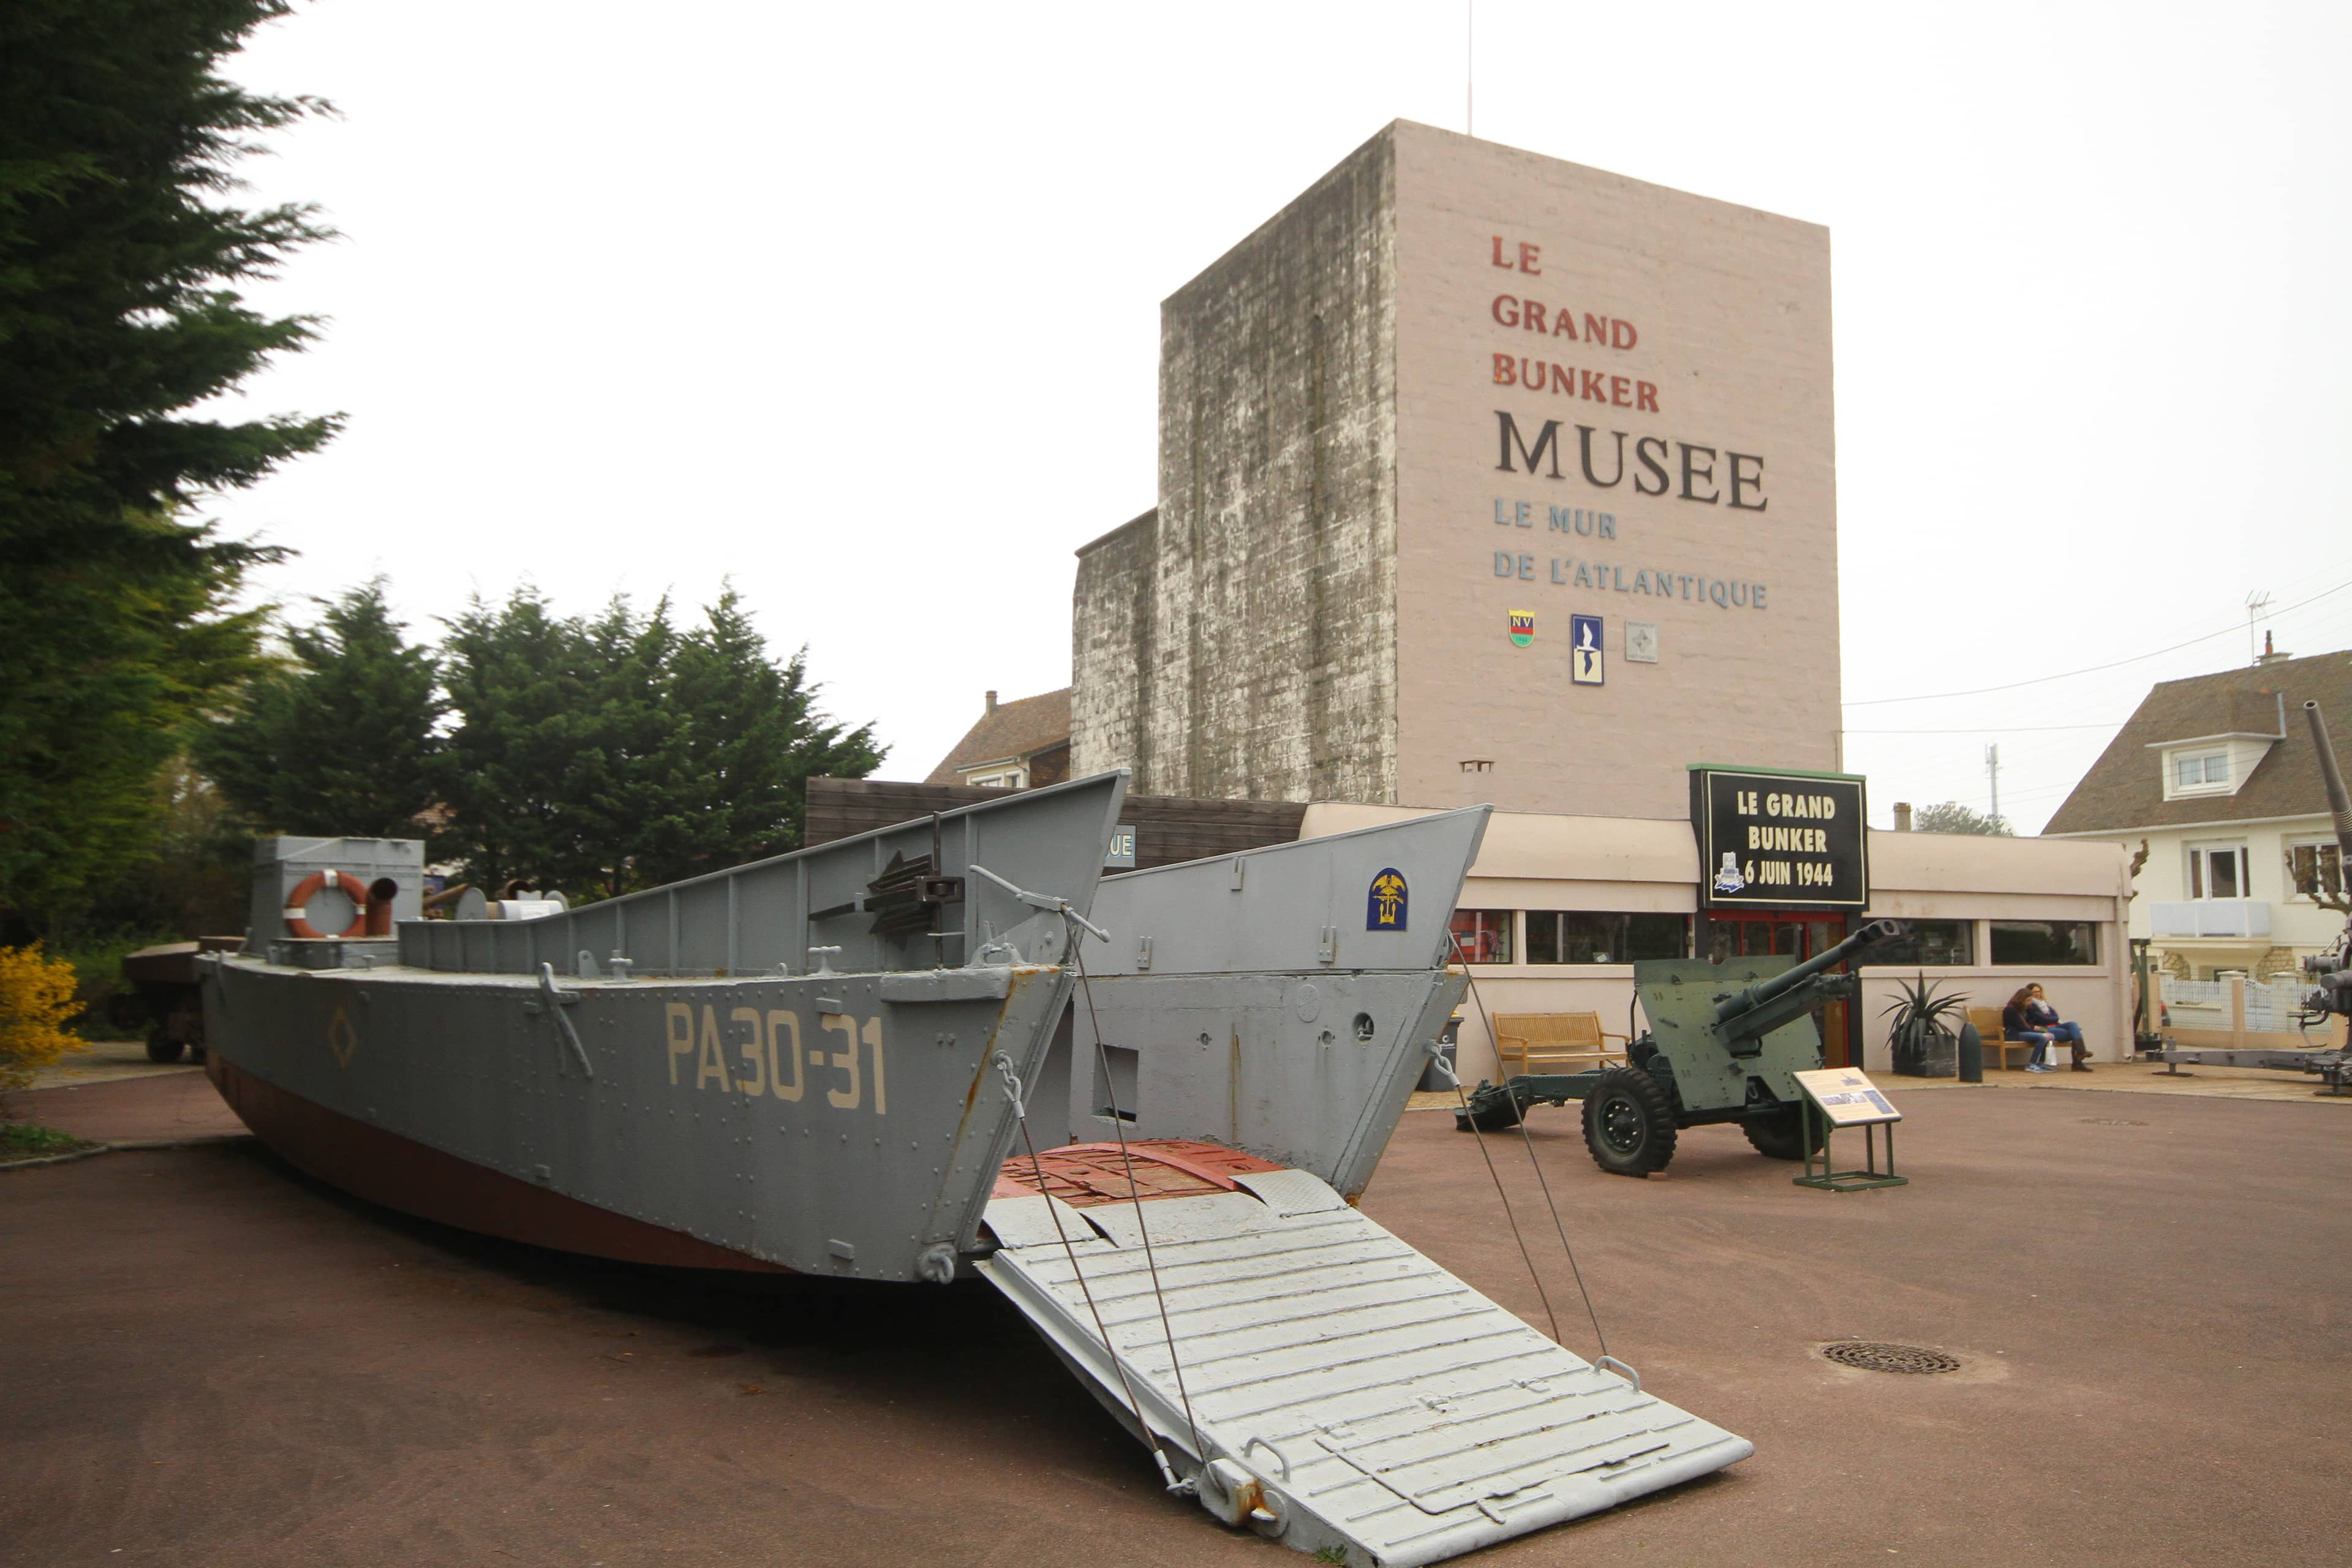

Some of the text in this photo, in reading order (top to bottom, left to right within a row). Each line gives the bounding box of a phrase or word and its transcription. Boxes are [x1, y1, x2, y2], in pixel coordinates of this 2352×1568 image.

[1492, 235, 1541, 275] LE
[1491, 294, 1637, 350] GRAND
[1492, 353, 1660, 412] BUNKER
[1494, 410, 1768, 512] MUSEE
[1494, 499, 1617, 539] LE MUR
[1494, 551, 1768, 609] DE L'ATLANTIQUE
[1513, 616, 1531, 627] NV
[1737, 791, 1836, 820] LE GRAND
[1749, 826, 1828, 853] BUNKER
[1745, 860, 1833, 887] 6 JUIN 1944
[665, 1002, 887, 1115] PA30-31
